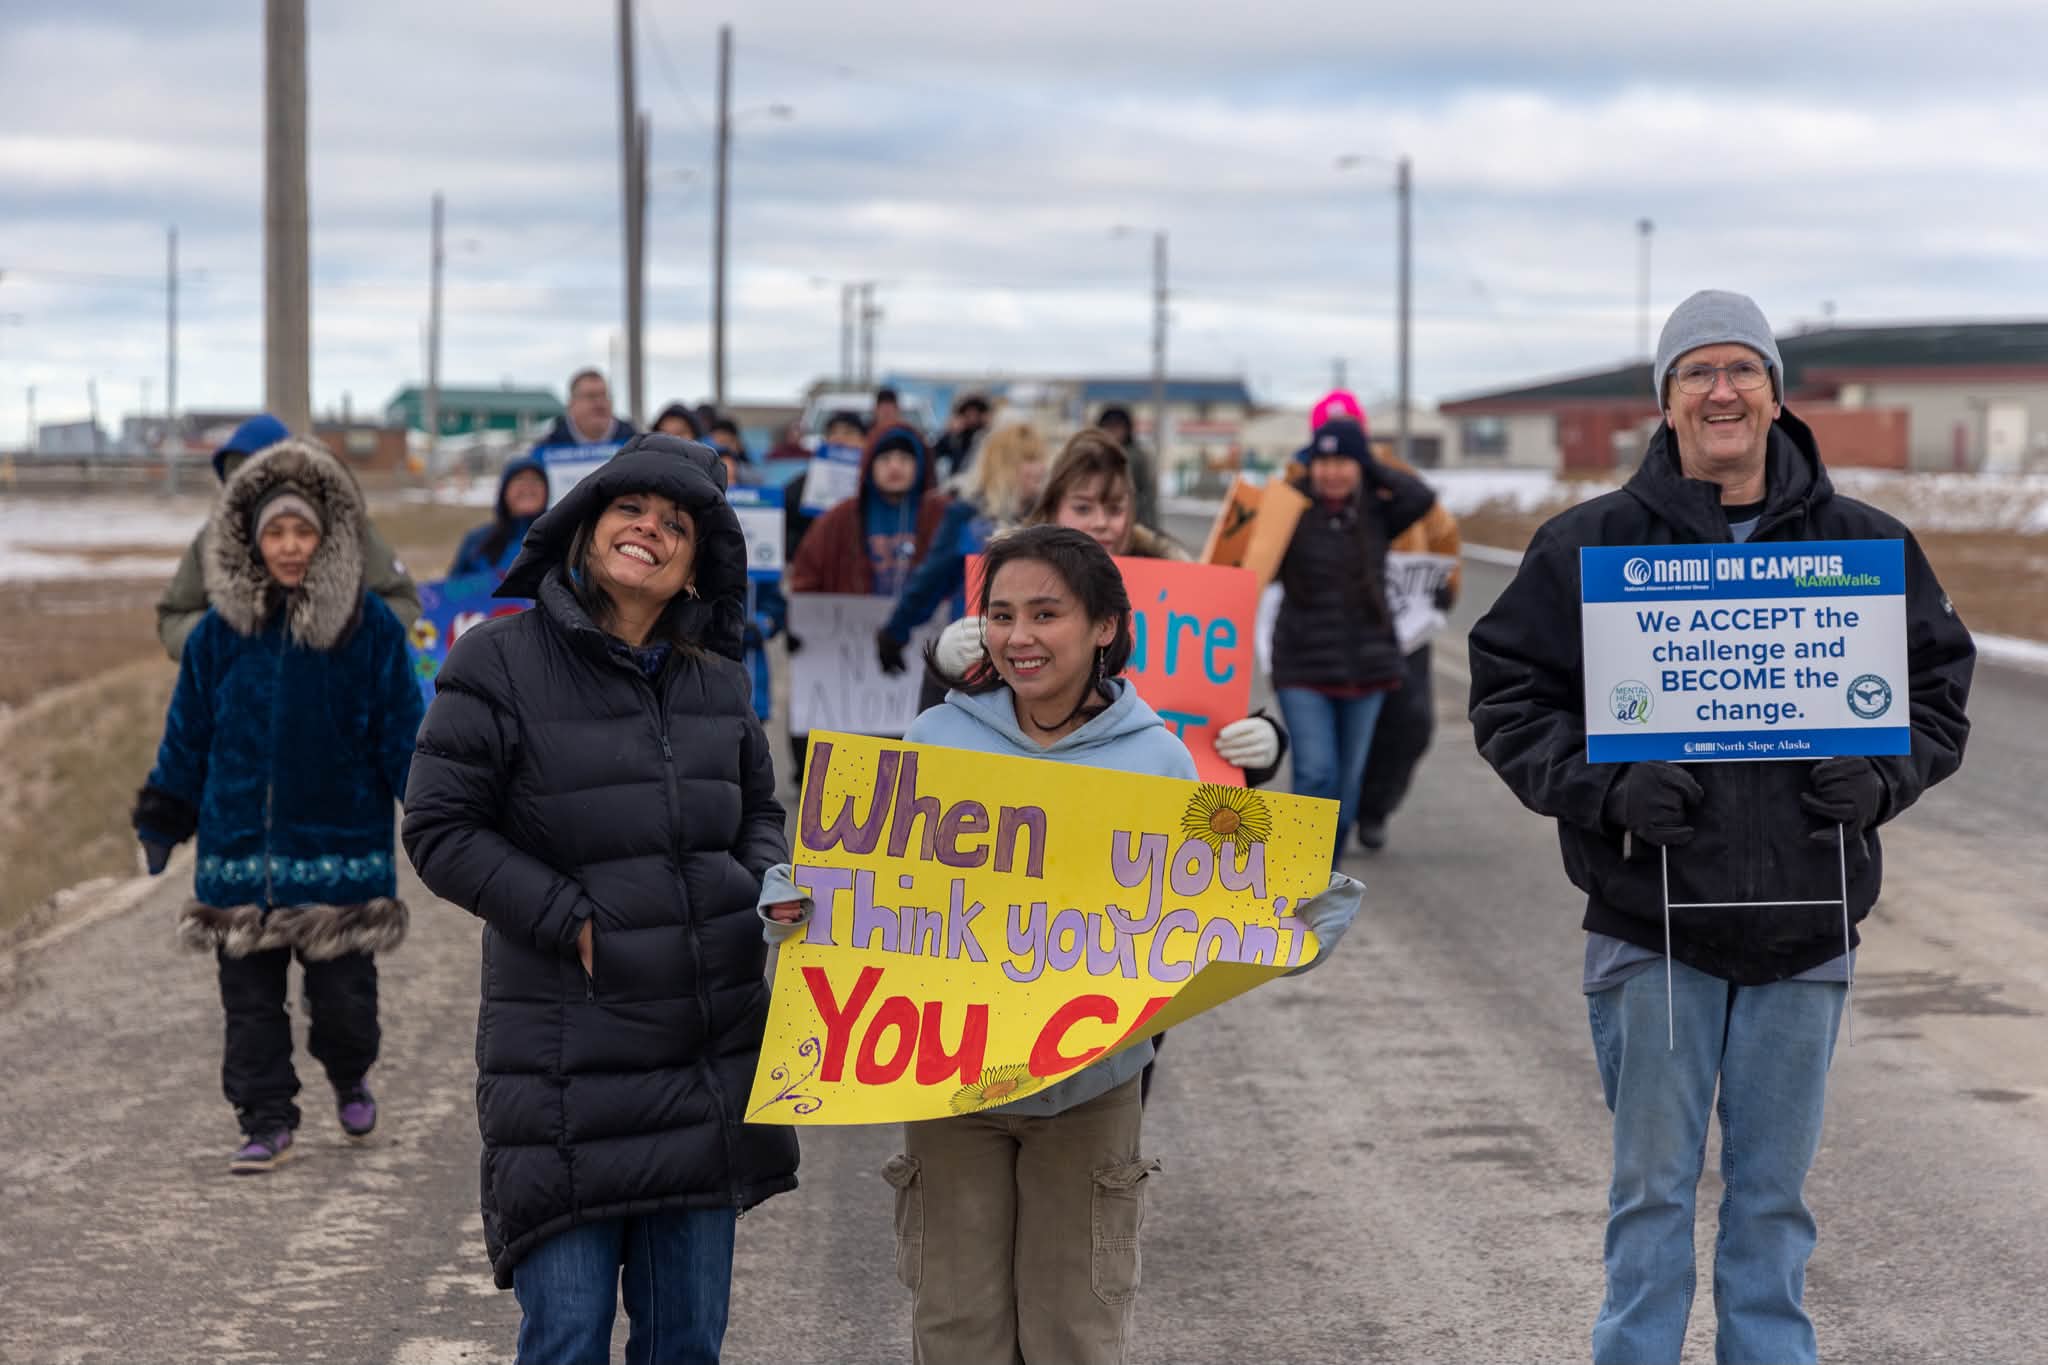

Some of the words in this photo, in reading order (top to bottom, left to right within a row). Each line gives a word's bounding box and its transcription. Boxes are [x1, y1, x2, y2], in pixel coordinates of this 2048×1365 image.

[1653, 558, 1710, 583] NAMI
[1716, 557, 1746, 581] ON
[1751, 554, 1844, 580] CAMPUS
[1795, 572, 1881, 590] NAMIWalks
[1636, 610, 1681, 633] We
[1688, 607, 1807, 633] ACCEPT
[1814, 605, 1860, 629] the
[1652, 639, 1786, 665] challenge
[1794, 636, 1846, 659] and
[1661, 667, 1786, 692] BECOME
[1793, 666, 1839, 689] the
[1696, 699, 1805, 725] change.
[1716, 740, 1745, 752] North
[1747, 740, 1775, 753] Slope
[1777, 739, 1811, 751] Alaska
[800, 741, 1048, 880] When
[1105, 829, 1268, 935] you
[794, 863, 989, 963] Think
[1000, 901, 1139, 984] you
[800, 966, 990, 1087] You
